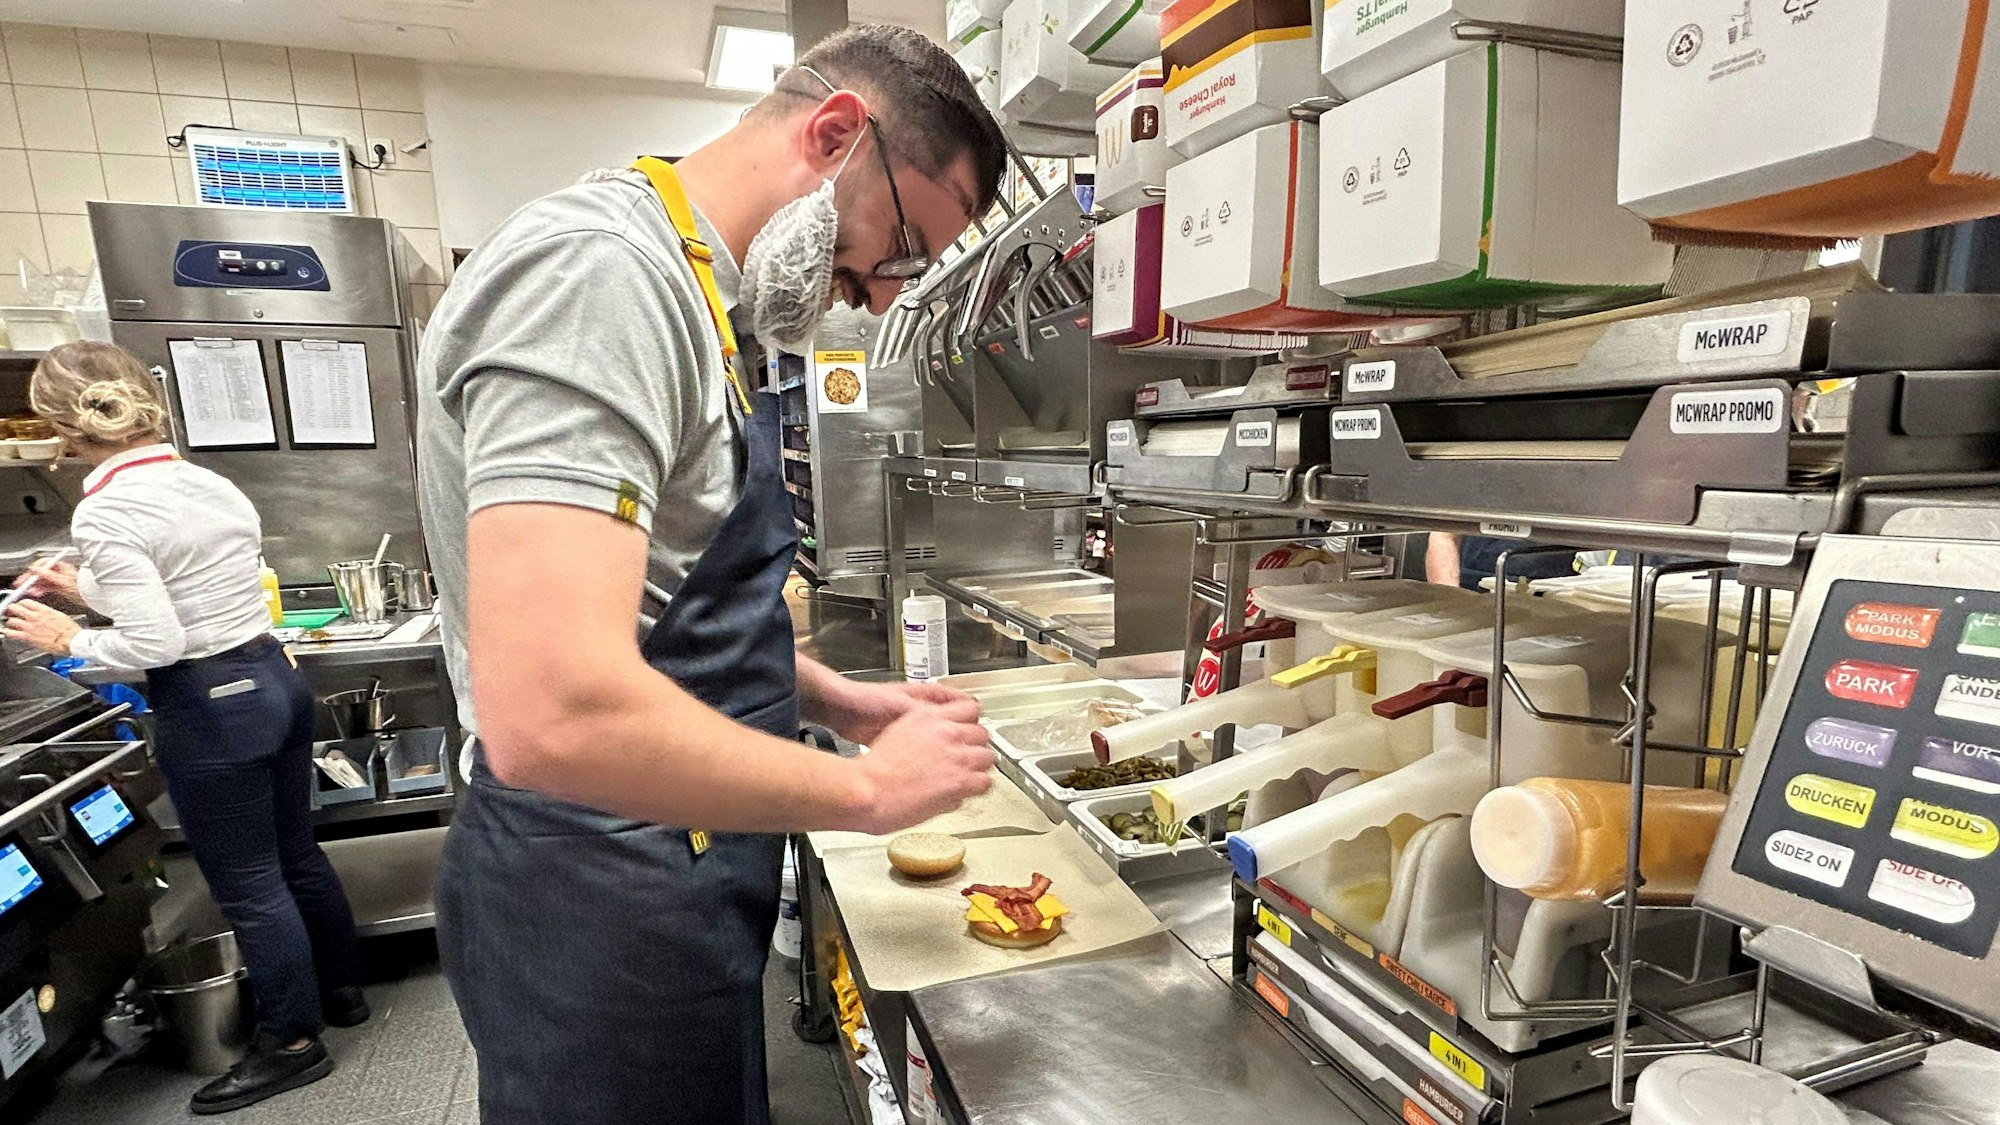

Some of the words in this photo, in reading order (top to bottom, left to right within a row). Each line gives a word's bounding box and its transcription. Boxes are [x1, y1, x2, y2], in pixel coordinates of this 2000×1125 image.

[1356, 2, 1372, 21] TS
[1356, 1, 1408, 36] Hamburger
[1792, 11, 1814, 25] PAP
[1211, 73, 1236, 97] Royal
[1179, 88, 1210, 111] Cheese
[1190, 96, 1226, 119] Hamburger
[1695, 324, 1768, 350] McWRAP
[1355, 369, 1386, 384] McWRAP
[1677, 403, 1726, 422] MCWRAP
[1730, 400, 1774, 421] PROMO
[1358, 418, 1377, 431] PROMO
[1868, 612, 1914, 626] PARK
[1855, 623, 1920, 639] MODUS
[1836, 673, 1897, 696] PARK
[1790, 785, 1867, 815] DRUCKEN
[1771, 840, 1813, 863] SIDE2
[1817, 855, 1842, 872] ON
[1386, 959, 1406, 981] SWEET
[1425, 986, 1446, 1009] SAUCE
[1445, 1050, 1450, 1062] 4
[1452, 1054, 1461, 1070] IN
[1420, 1078, 1463, 1123] HAMBURGER
